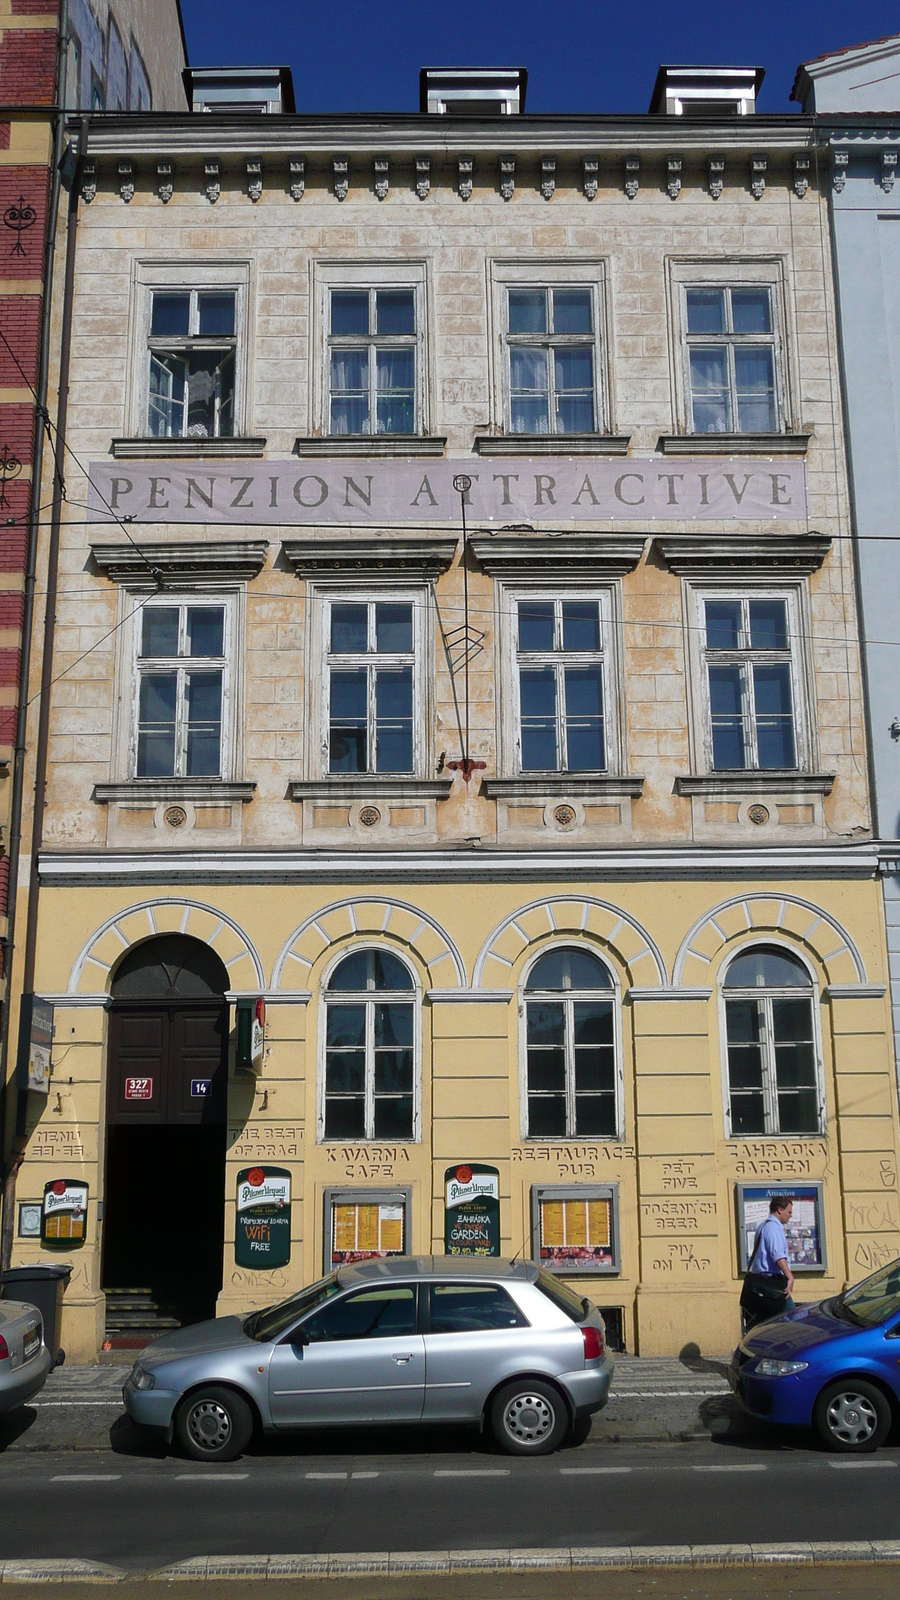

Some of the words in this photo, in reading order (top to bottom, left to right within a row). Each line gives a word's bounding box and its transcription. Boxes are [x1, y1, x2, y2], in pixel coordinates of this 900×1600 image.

[110, 475, 374, 509] PENZION
[410, 473, 792, 507] ATTRACTIVE
[129, 1080, 148, 1089] 327
[195, 1083, 207, 1093] 14
[37, 1131, 81, 1142] MENU
[228, 1128, 260, 1140] THE
[263, 1127, 305, 1139] BEST
[235, 1144, 254, 1156] OF
[256, 1144, 297, 1156] PRAG
[511, 1146, 636, 1161] RESTAURACE
[345, 1164, 394, 1178] CAFE
[557, 1163, 595, 1177] PUB
[735, 1160, 811, 1174] GARDEN
[662, 1177, 698, 1189] FIVE
[242, 1186, 265, 1203] Pilsner
[264, 1185, 286, 1198] Urquell
[451, 1183, 473, 1200] Pilsner
[472, 1182, 494, 1196] Urquell
[655, 1217, 698, 1229] BEER
[450, 1229, 489, 1240] GARDEN
[250, 1242, 270, 1251] FREE
[668, 1244, 693, 1257] PIV
[652, 1259, 673, 1271] ON
[680, 1258, 711, 1271] TAP
